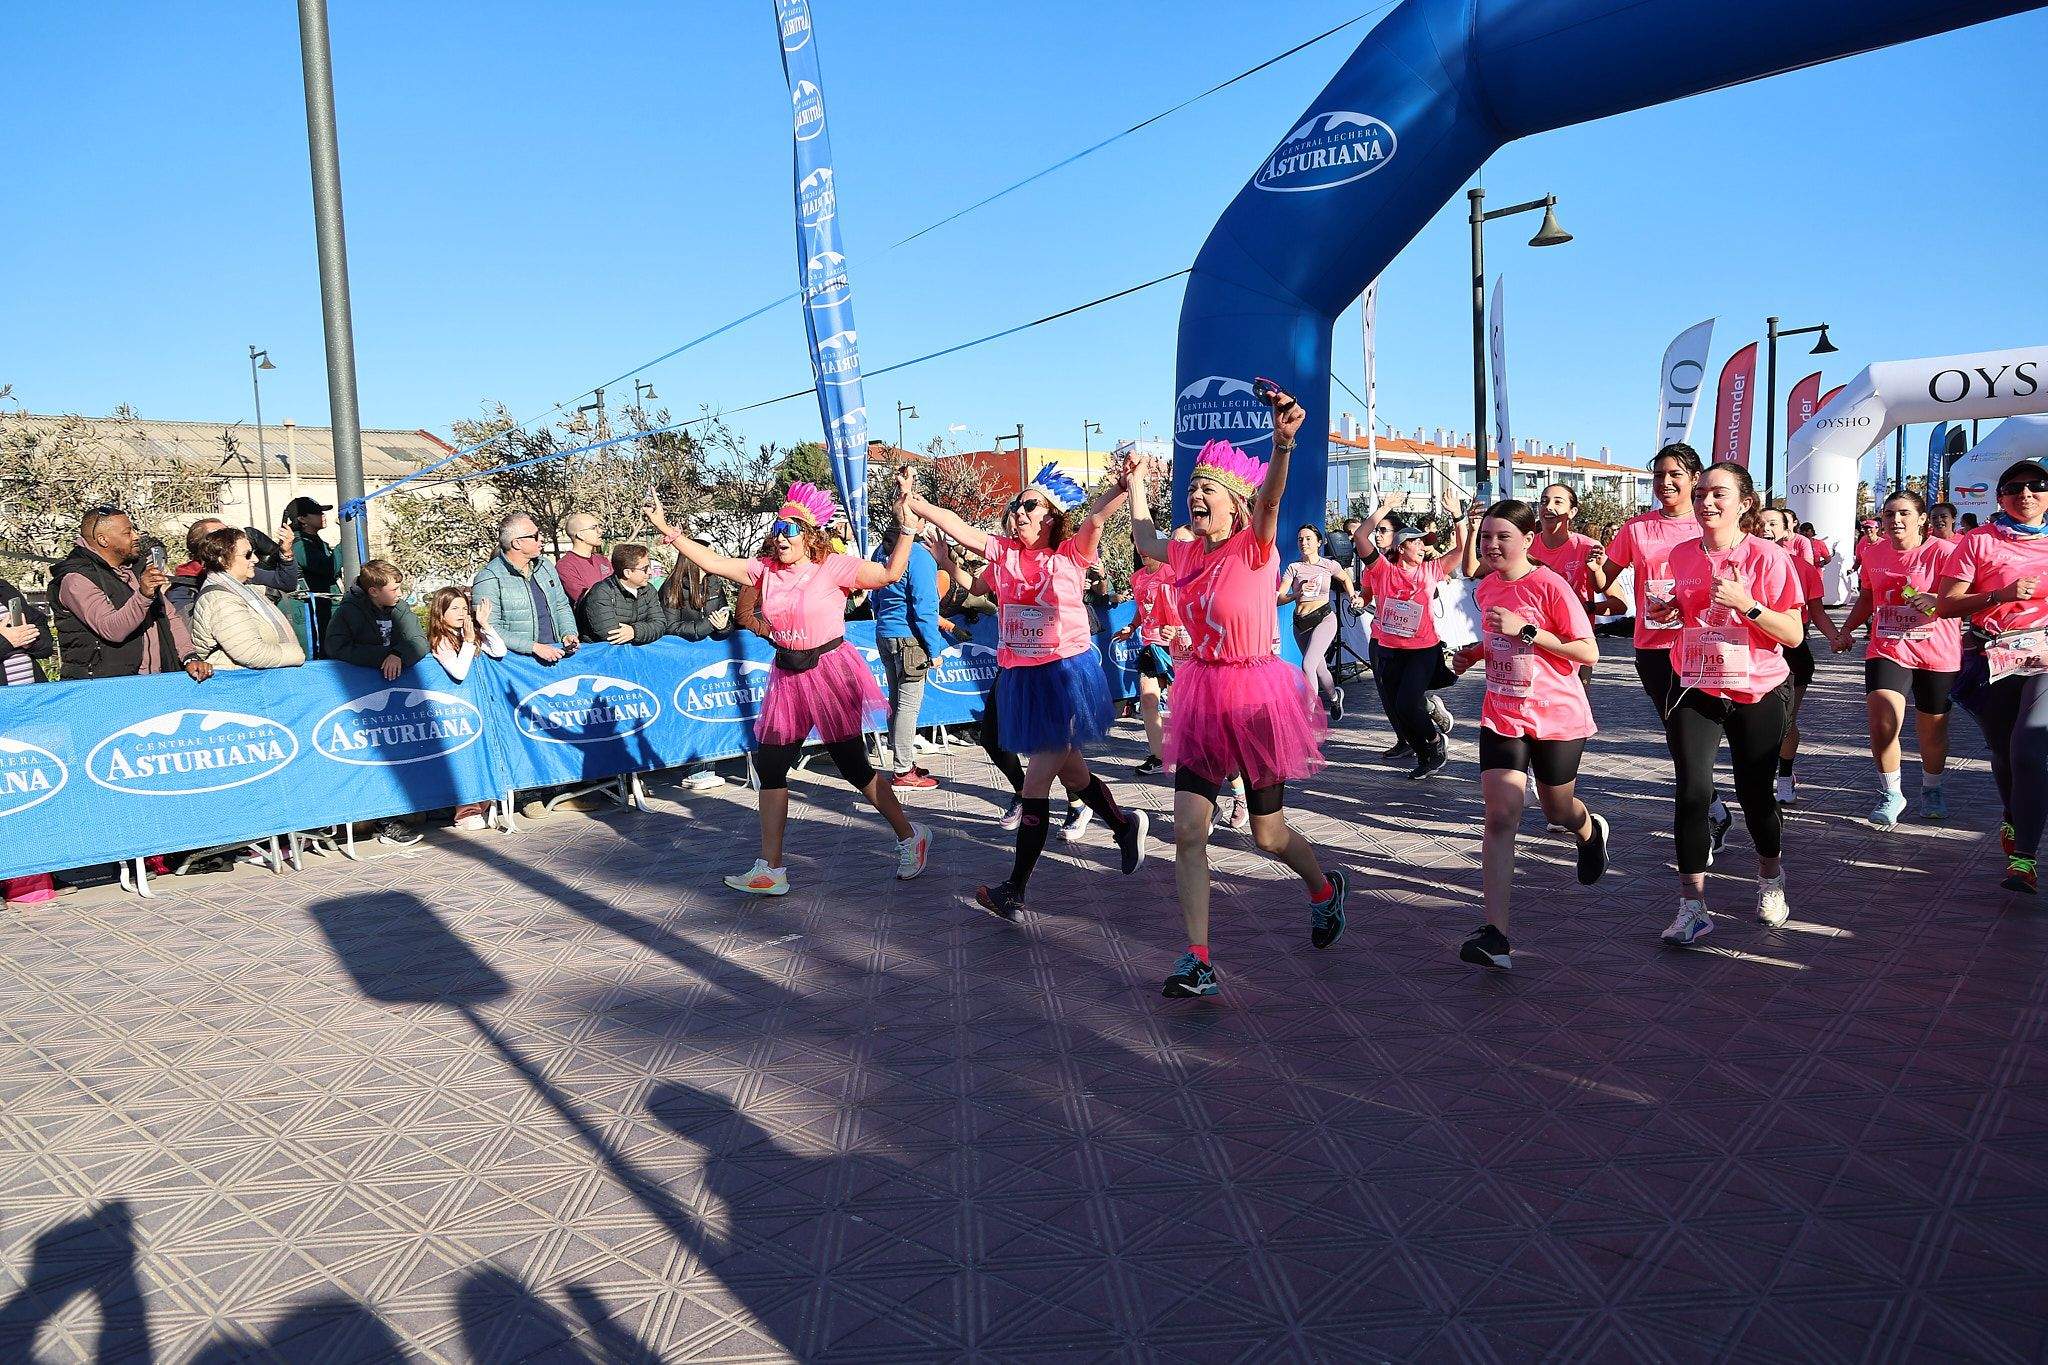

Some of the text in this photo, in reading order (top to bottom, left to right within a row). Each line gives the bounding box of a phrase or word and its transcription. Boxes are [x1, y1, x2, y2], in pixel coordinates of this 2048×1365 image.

[1282, 128, 1378, 157] CENTRAL LECHERA
[1259, 139, 1385, 184] ASTURIANA
[1928, 362, 2048, 404] OYS
[1183, 401, 1218, 411] CENTRAL
[1725, 373, 1746, 461] Santander
[1174, 406, 1275, 434] ASTURIANA
[1816, 416, 1871, 430] OYSHO
[1790, 483, 1840, 495] OYSHO
[1393, 615, 1409, 623] 016
[1022, 628, 1044, 637] 016
[1493, 661, 1512, 672] 016
[701, 679, 742, 691] CENTRAL
[548, 692, 644, 709] CENTRAL LECHERA
[352, 705, 466, 727] CENTRAL LECHERA
[526, 701, 654, 732] ASTURIANA
[135, 729, 276, 753] CENTRAL LECHERA
[328, 716, 475, 753] ASTURIANA
[105, 738, 287, 782] ASTURIANA
